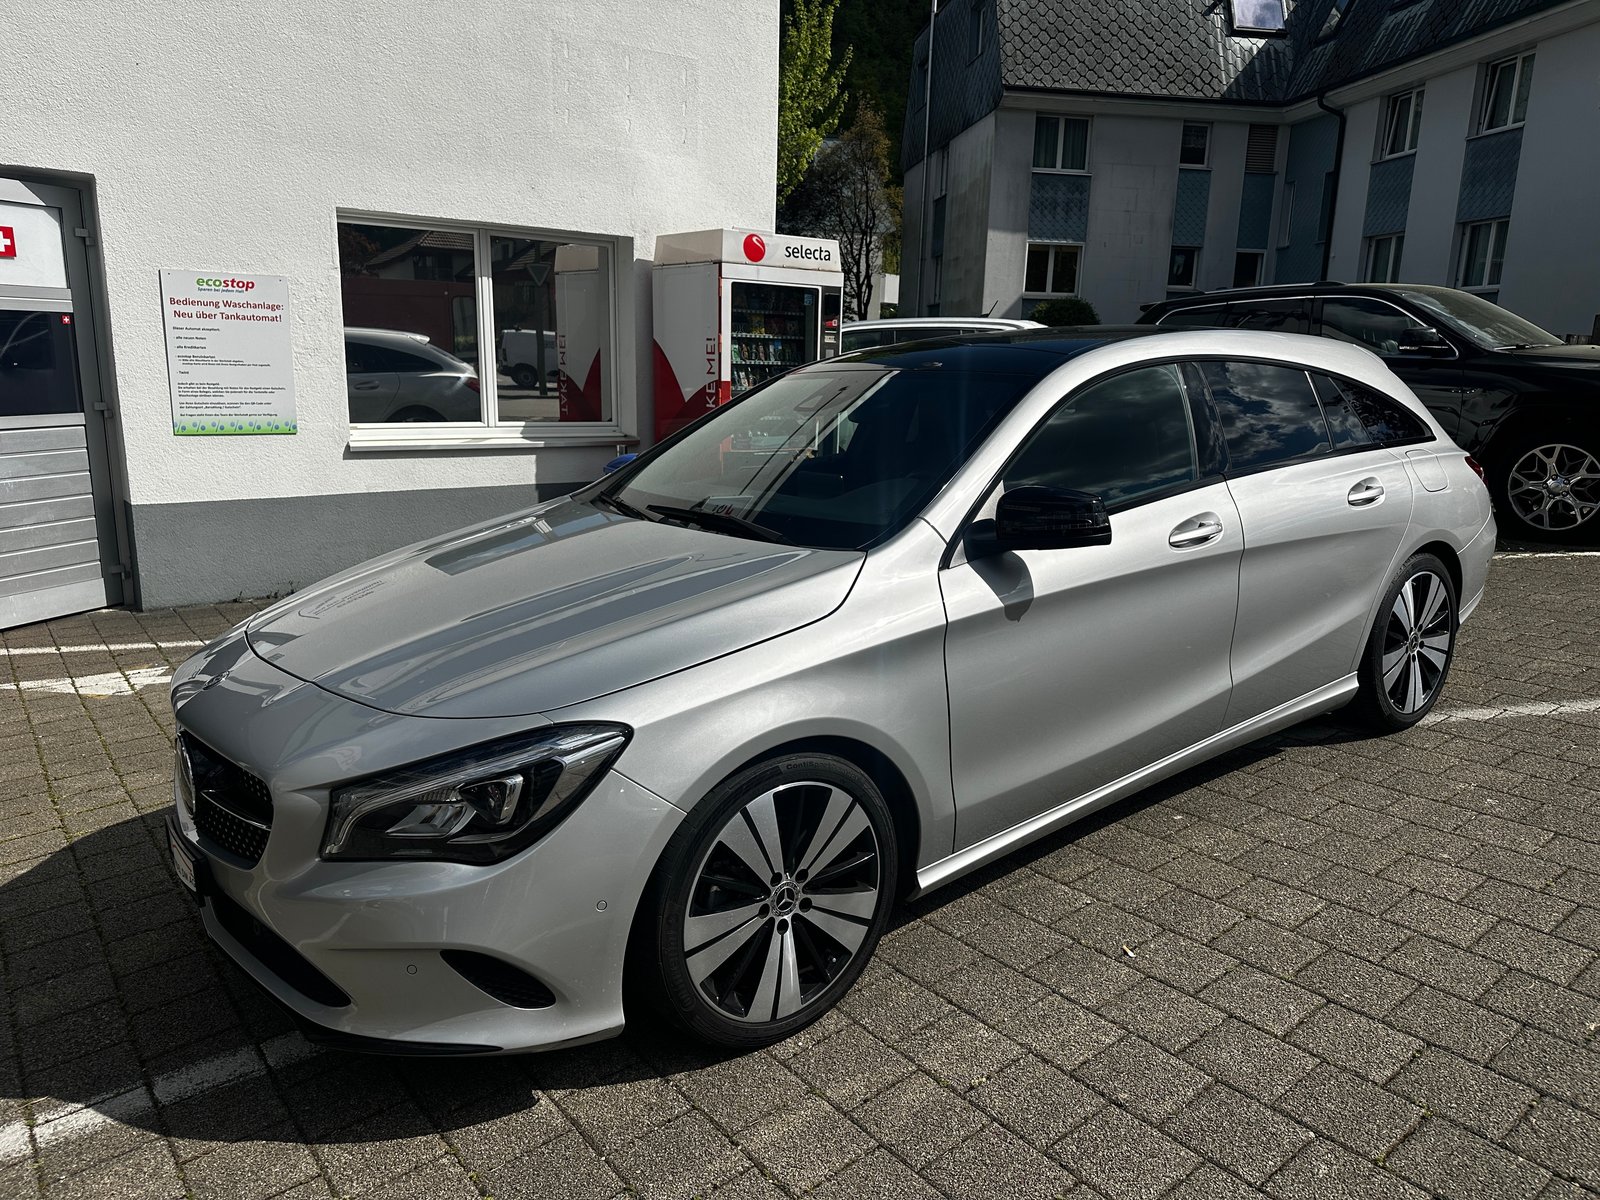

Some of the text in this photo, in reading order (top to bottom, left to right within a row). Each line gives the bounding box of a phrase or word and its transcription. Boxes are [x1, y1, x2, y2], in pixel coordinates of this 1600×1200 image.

[784, 244, 831, 261] selecta
[196, 278, 255, 291] ecostop
[169, 297, 284, 311] Bedienung Waschanlage:
[173, 310, 282, 322] Neu über Tankautomat!
[706, 338, 716, 408] KE ME!
